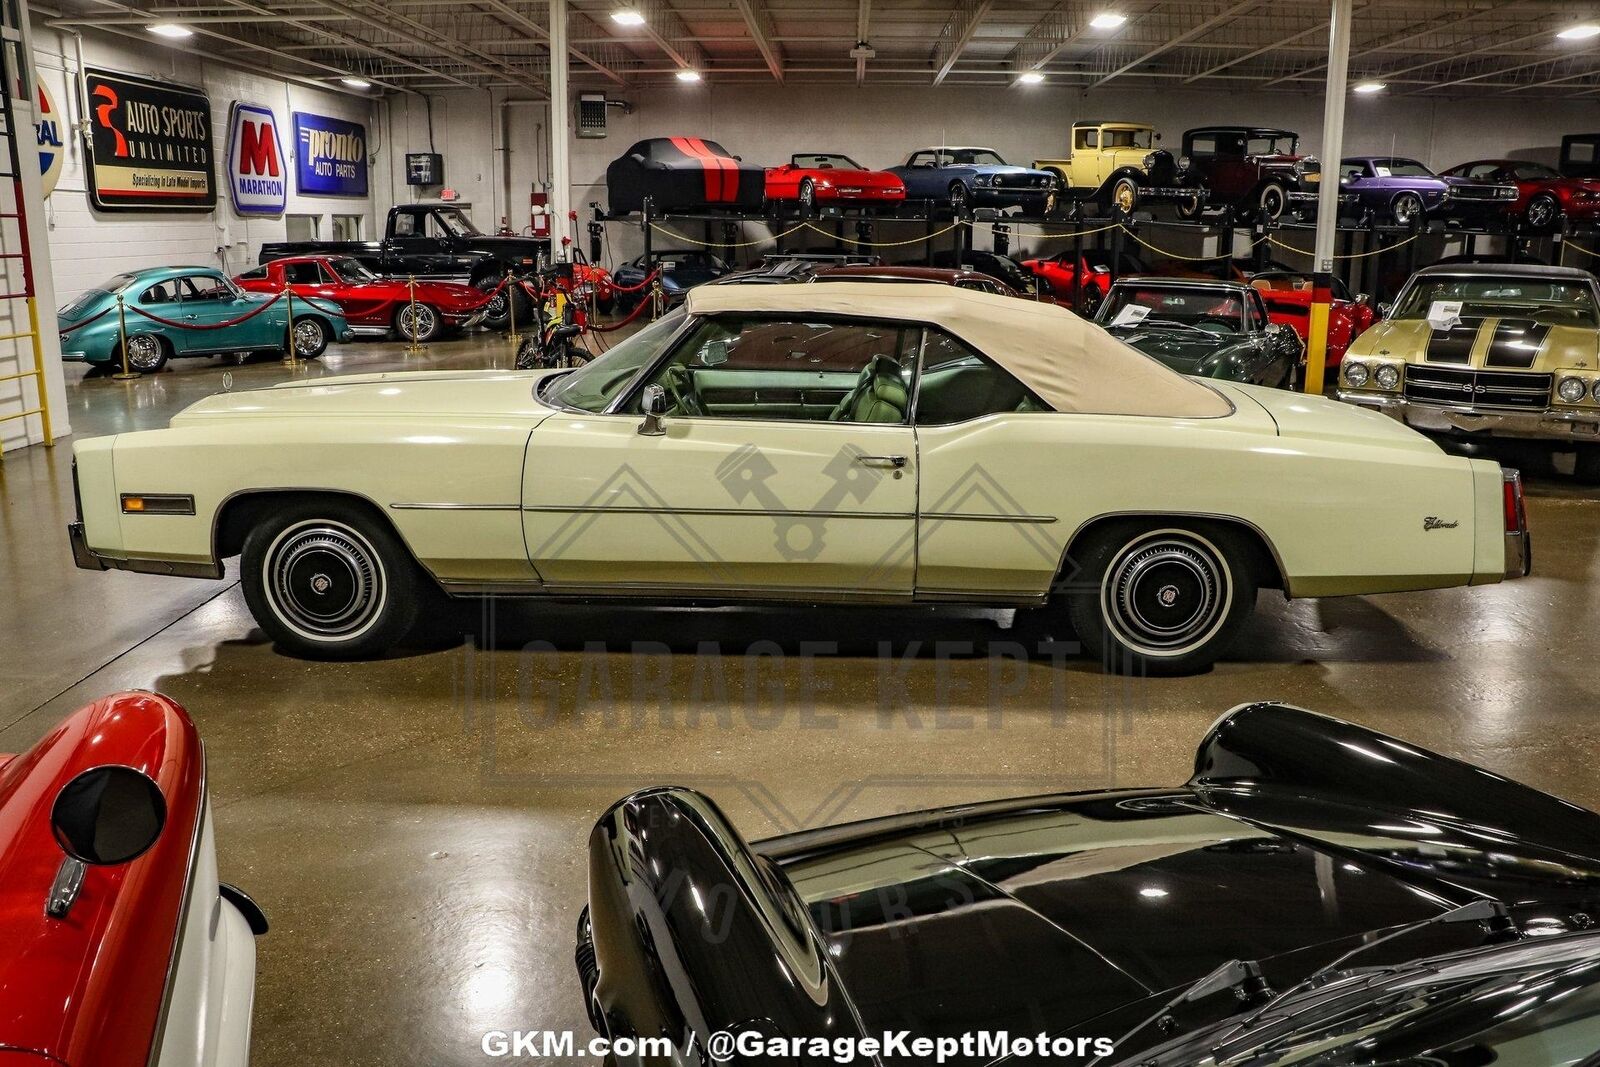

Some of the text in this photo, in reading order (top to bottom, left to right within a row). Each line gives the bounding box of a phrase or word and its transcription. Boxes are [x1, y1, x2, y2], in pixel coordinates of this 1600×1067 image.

[126, 100, 206, 141] AUTO SPORTS
[128, 140, 207, 164] UNLIMITED
[308, 128, 364, 166] pronto
[315, 161, 356, 179] AUTO PARTS
[239, 178, 283, 196] MARATHON
